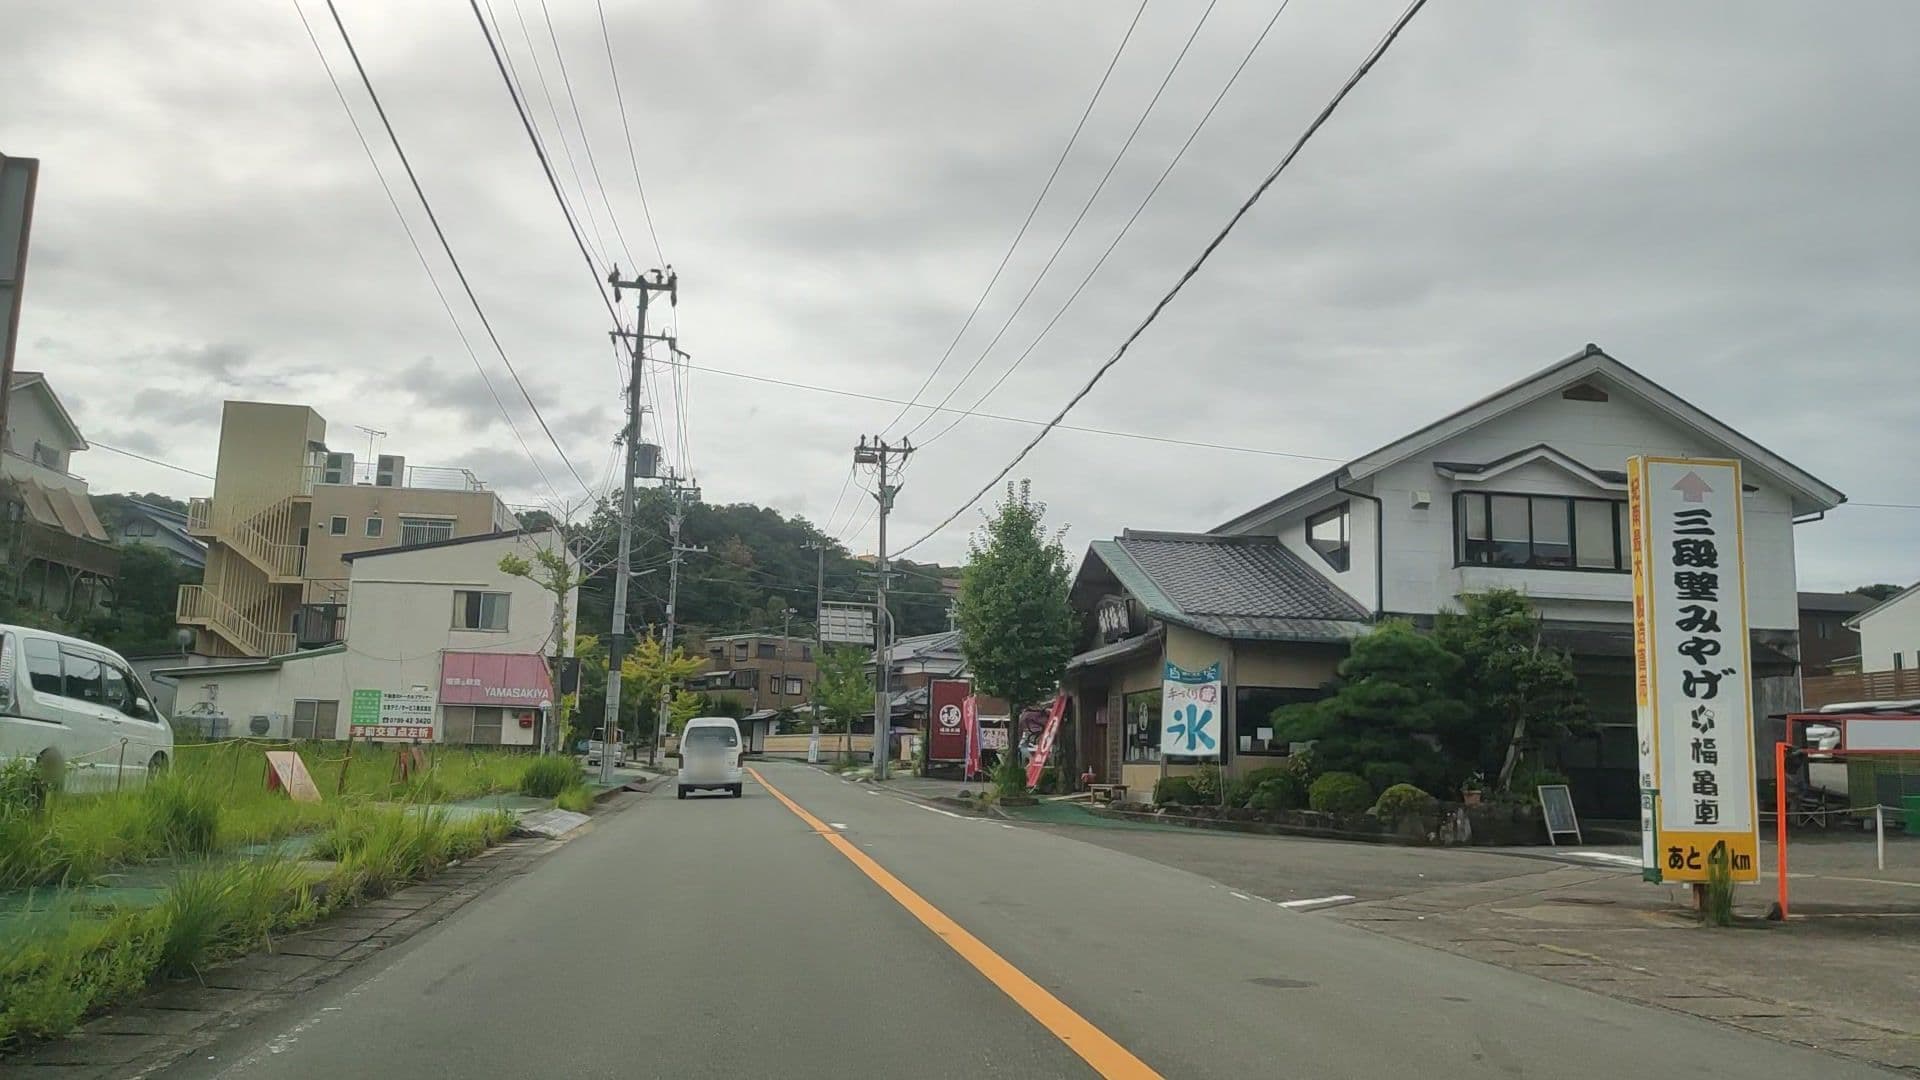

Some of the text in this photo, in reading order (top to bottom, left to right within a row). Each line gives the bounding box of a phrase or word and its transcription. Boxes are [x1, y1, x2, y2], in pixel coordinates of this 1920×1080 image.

[1671, 508, 1736, 700] 三段壁みやげ
[484, 687, 549, 699] YAMASAKIYA
[354, 726, 428, 738] 手前交差点左折
[1167, 703, 1216, 751] 氷
[1692, 738, 1720, 825] 福亀堂
